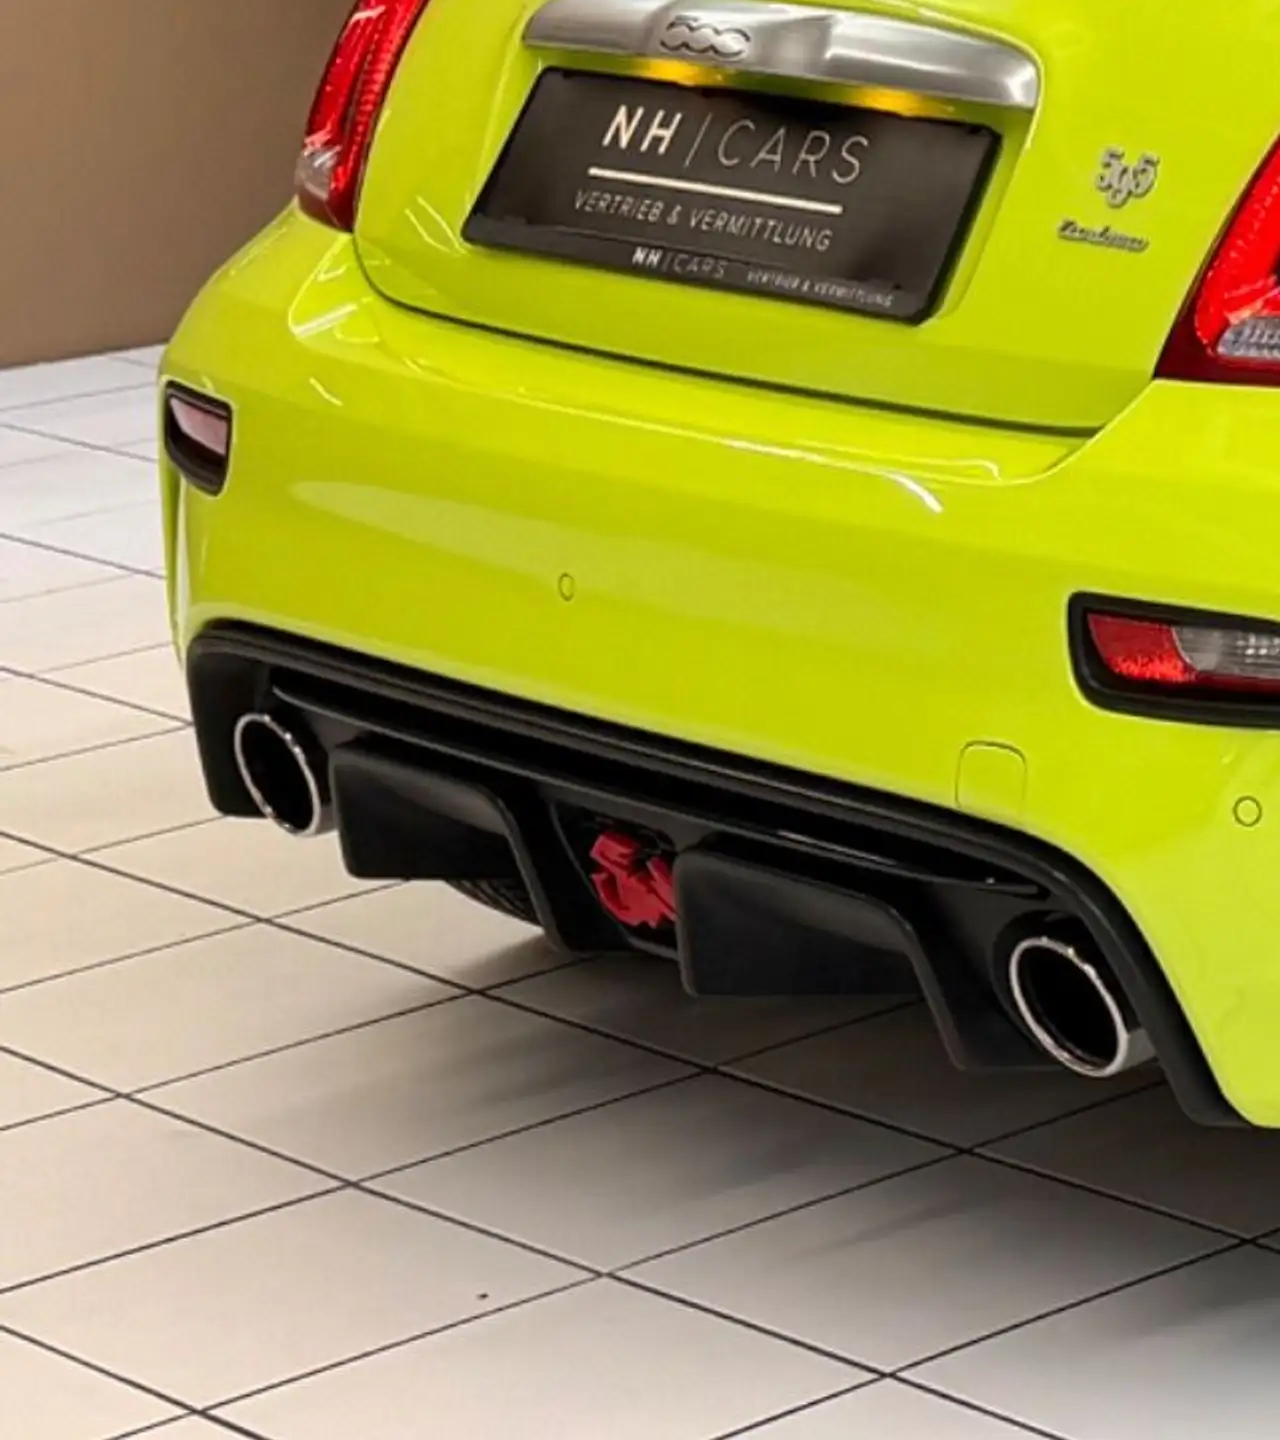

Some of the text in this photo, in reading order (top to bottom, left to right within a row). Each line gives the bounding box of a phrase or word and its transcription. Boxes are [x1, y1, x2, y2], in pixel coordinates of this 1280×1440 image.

[602, 104, 869, 185] NH CARS
[574, 190, 834, 252] VERTRIEB & VERMITTLUNG
[632, 246, 729, 280] NH CARS
